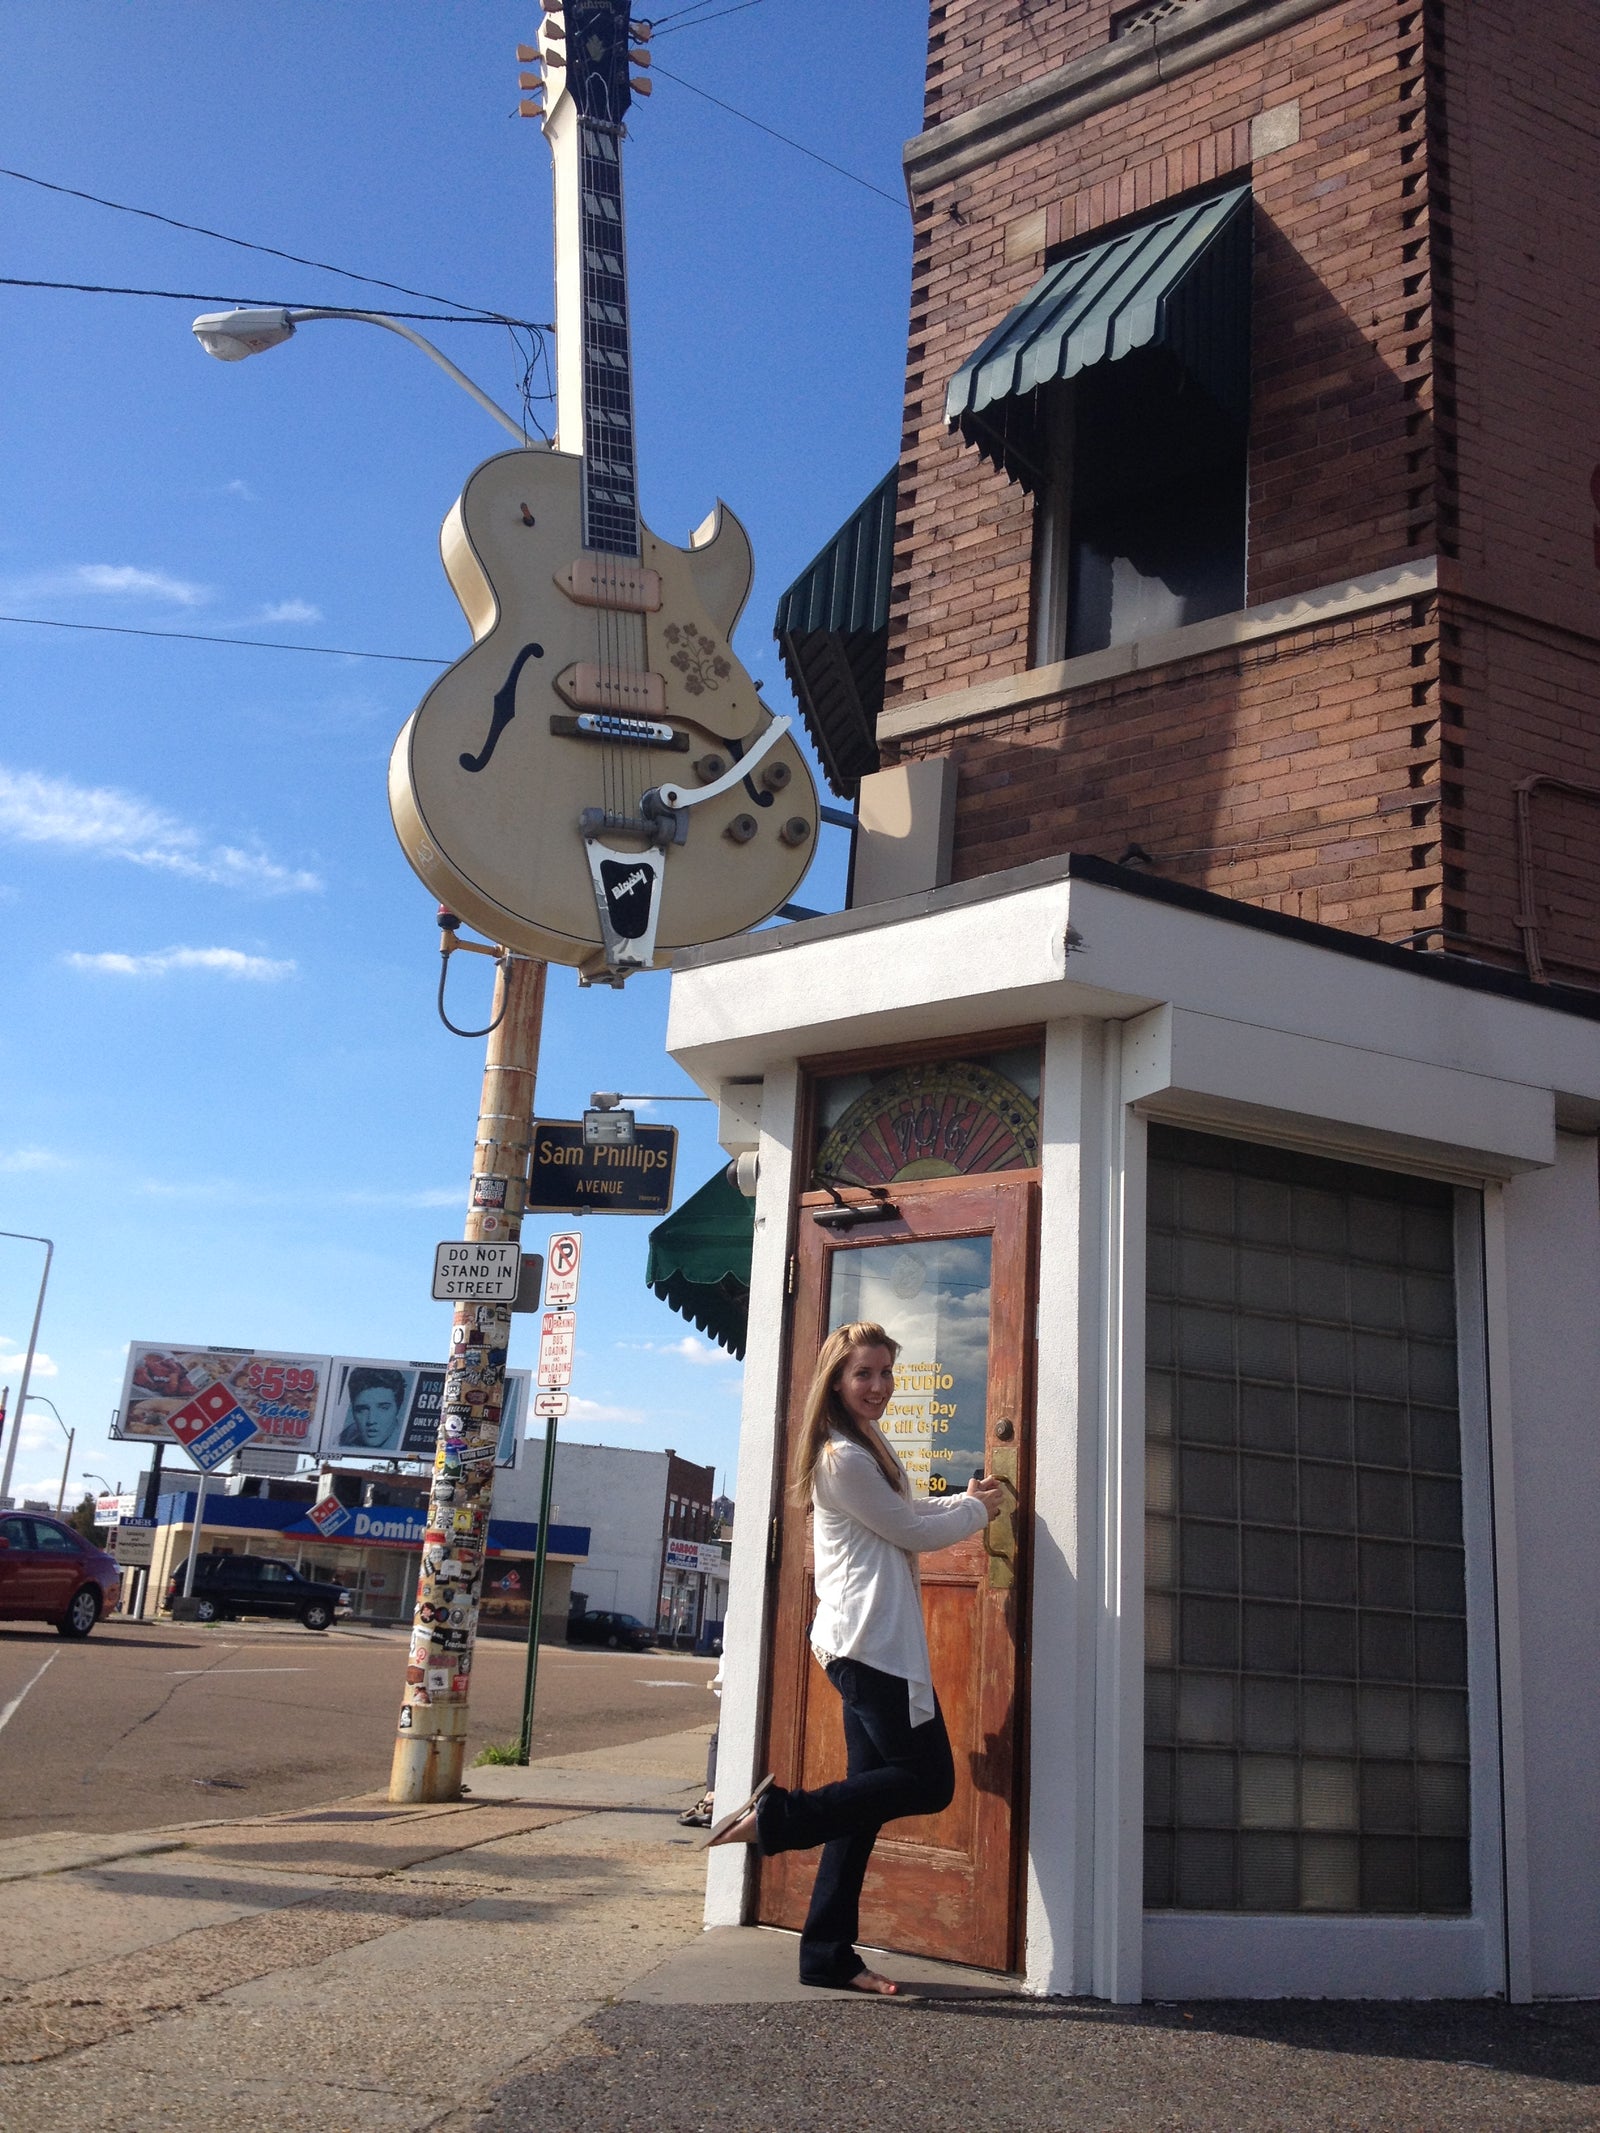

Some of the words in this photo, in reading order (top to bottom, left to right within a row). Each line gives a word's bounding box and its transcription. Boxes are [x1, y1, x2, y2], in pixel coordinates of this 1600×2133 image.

[892, 1106, 969, 1151] 706
[540, 1140, 584, 1166] Sam
[593, 1143, 668, 1174] Phillips
[576, 1179, 625, 1195] AVENUE
[449, 1248, 469, 1261] DO
[476, 1249, 507, 1262] NOT
[440, 1264, 489, 1278] STAND
[497, 1265, 512, 1278] IN
[446, 1281, 503, 1294] STREET
[549, 1281, 560, 1292] Any
[562, 1280, 575, 1291] Time
[543, 1316, 553, 1332] NO
[553, 1318, 574, 1329] PARKING
[545, 1345, 568, 1357] LOADING
[540, 1362, 572, 1374] UNLOADING
[422, 1379, 444, 1393] VISI
[894, 1373, 954, 1391] STUDIO
[417, 1393, 444, 1411] GRA
[886, 1402, 926, 1418] Every
[929, 1400, 957, 1418] Day
[256, 1401, 310, 1420] Value
[257, 1417, 311, 1438] MENU
[413, 1416, 433, 1427] ONLY
[895, 1420, 913, 1434] till
[918, 1419, 949, 1434] 6:15
[190, 1412, 245, 1456] Domino's
[200, 1438, 235, 1467] Pizza
[897, 1449, 915, 1460] urs
[919, 1447, 954, 1461] Hourly
[906, 1461, 930, 1473] Past
[916, 1476, 948, 1491] 5:30
[354, 1513, 425, 1540] Domin
